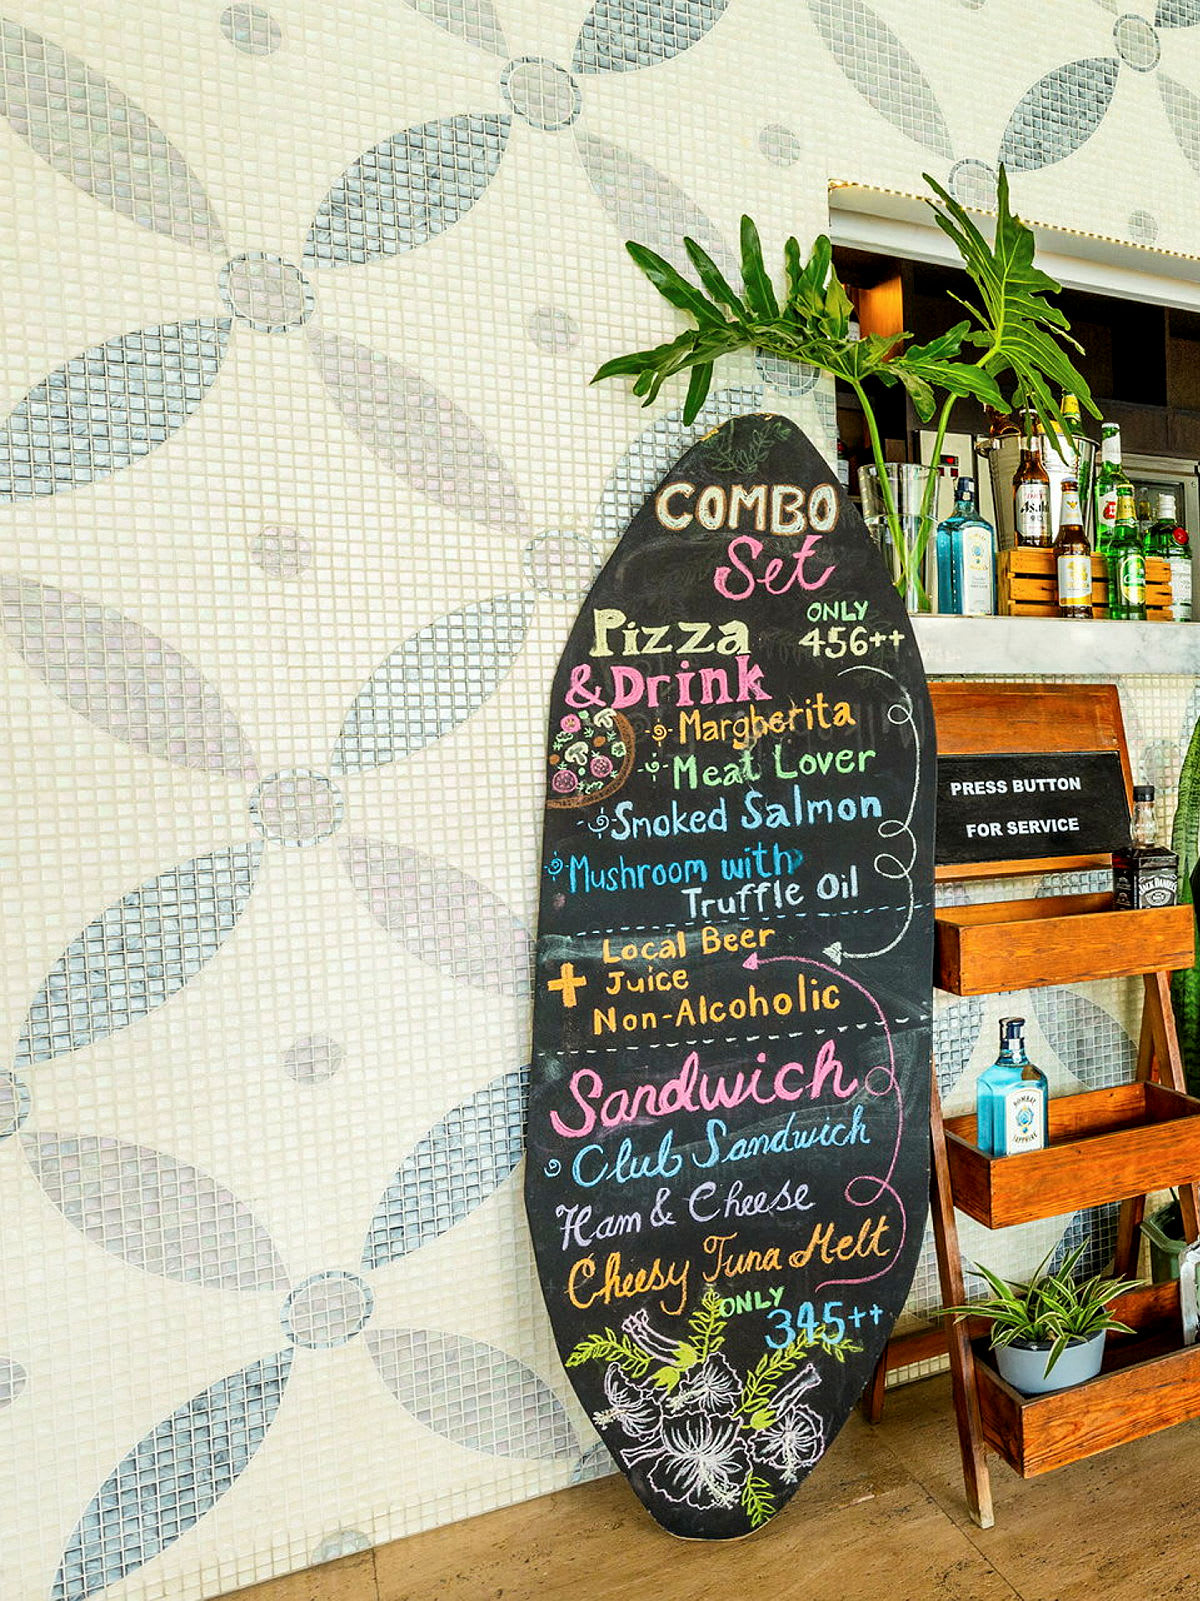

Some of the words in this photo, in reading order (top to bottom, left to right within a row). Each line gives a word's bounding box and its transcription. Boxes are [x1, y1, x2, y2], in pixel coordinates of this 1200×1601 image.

[655, 482, 840, 536] COMBO
[713, 534, 836, 600] Set
[589, 608, 752, 658] Pizza
[806, 600, 869, 622] ONLY
[798, 626, 905, 658] 456++
[679, 693, 857, 750] Margherita
[672, 749, 764, 790] Meat
[774, 743, 877, 780] Lover
[950, 780, 1008, 796] PRESS
[1013, 776, 1082, 794] BUTTON
[611, 800, 729, 841] Smoked
[741, 784, 882, 831] Salmon
[966, 821, 1004, 838] FOR
[1007, 817, 1080, 836] SERVICE
[568, 853, 709, 893] Mushroom
[721, 841, 804, 880] with
[681, 880, 804, 919] Truffle
[816, 864, 860, 900] Oil
[602, 930, 686, 965] Local
[702, 925, 776, 955] Beer
[593, 972, 841, 1035] Non-Alcoholic
[605, 965, 690, 996] Juice
[550, 1038, 859, 1139] Sandwich
[571, 1128, 684, 1188] Club
[691, 1103, 872, 1168] Sandwich
[555, 1203, 642, 1252] Ham
[649, 1187, 677, 1228] &
[688, 1179, 816, 1223] Cheese
[567, 1251, 691, 1316] Cheesy
[702, 1232, 783, 1283] Tuna
[788, 1214, 892, 1269] Melt
[718, 1285, 786, 1319] ONLY
[765, 1300, 885, 1350] 345++
